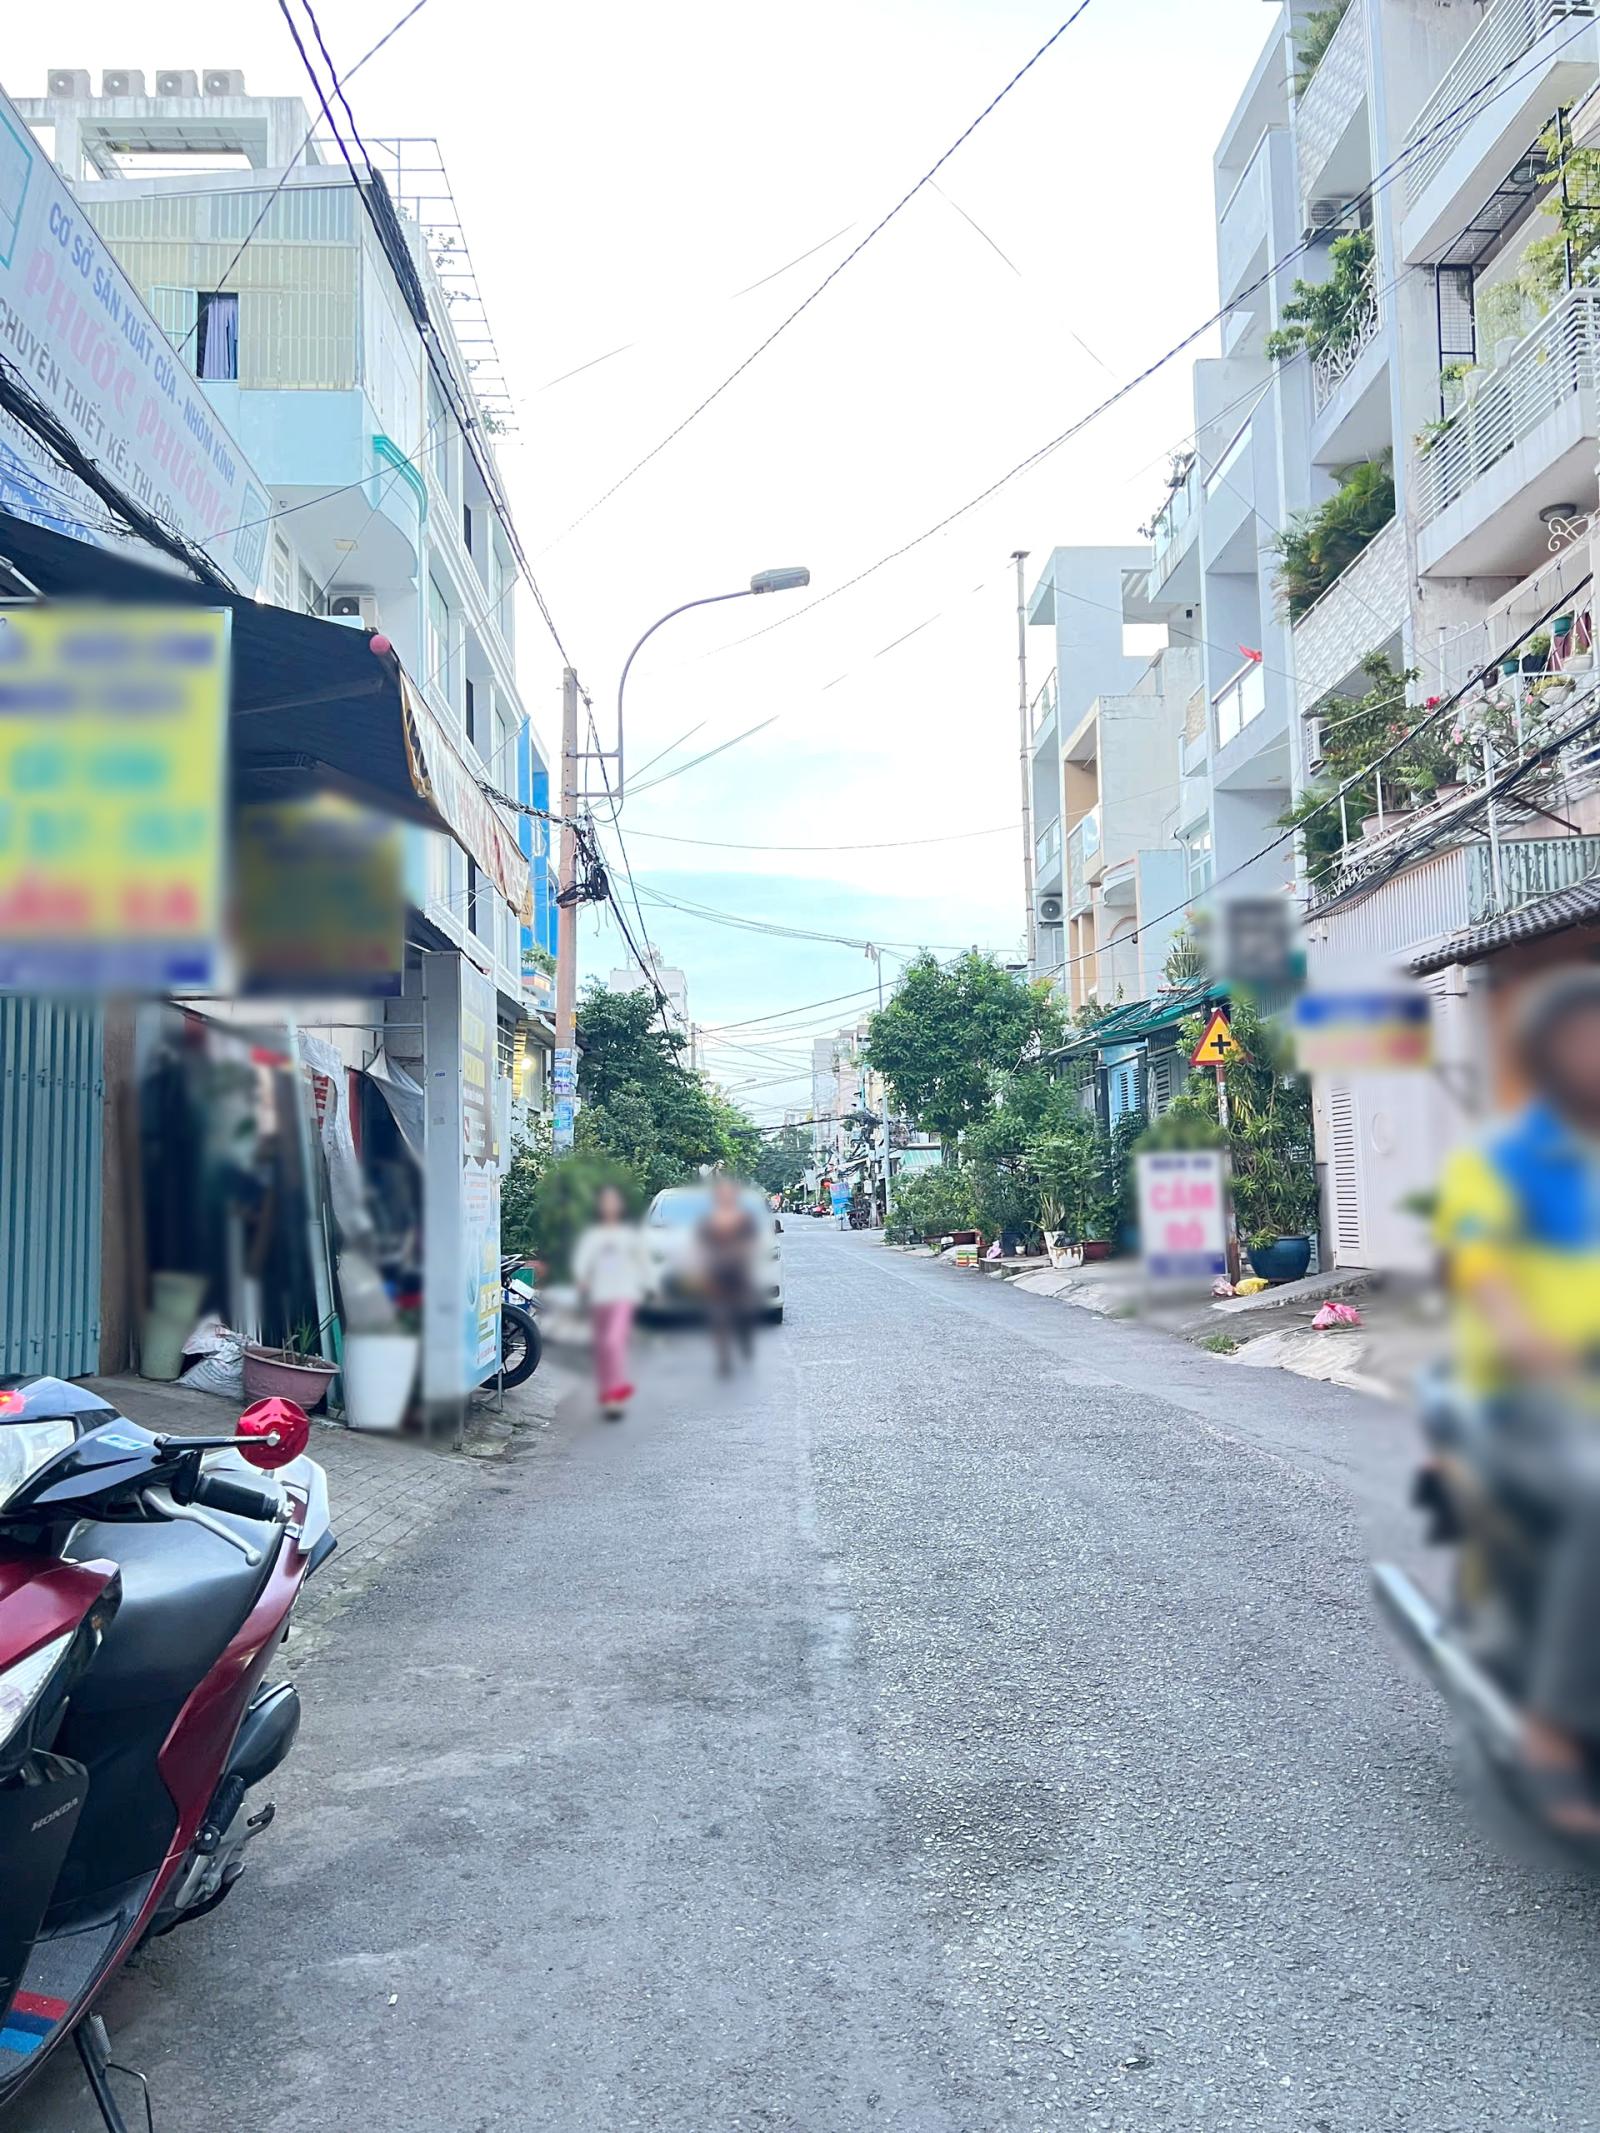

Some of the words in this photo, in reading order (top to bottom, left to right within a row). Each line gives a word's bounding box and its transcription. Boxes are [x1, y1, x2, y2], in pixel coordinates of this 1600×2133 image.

[49, 202, 74, 248] CƠ
[72, 234, 95, 278] SỞ
[93, 265, 121, 322] SẢN
[121, 304, 155, 366] XUẤT
[154, 354, 177, 404] CỬA
[213, 439, 236, 488] KÍNH
[64, 376, 106, 448] THIẾT
[31, 1797, 79, 1832] HONDA
